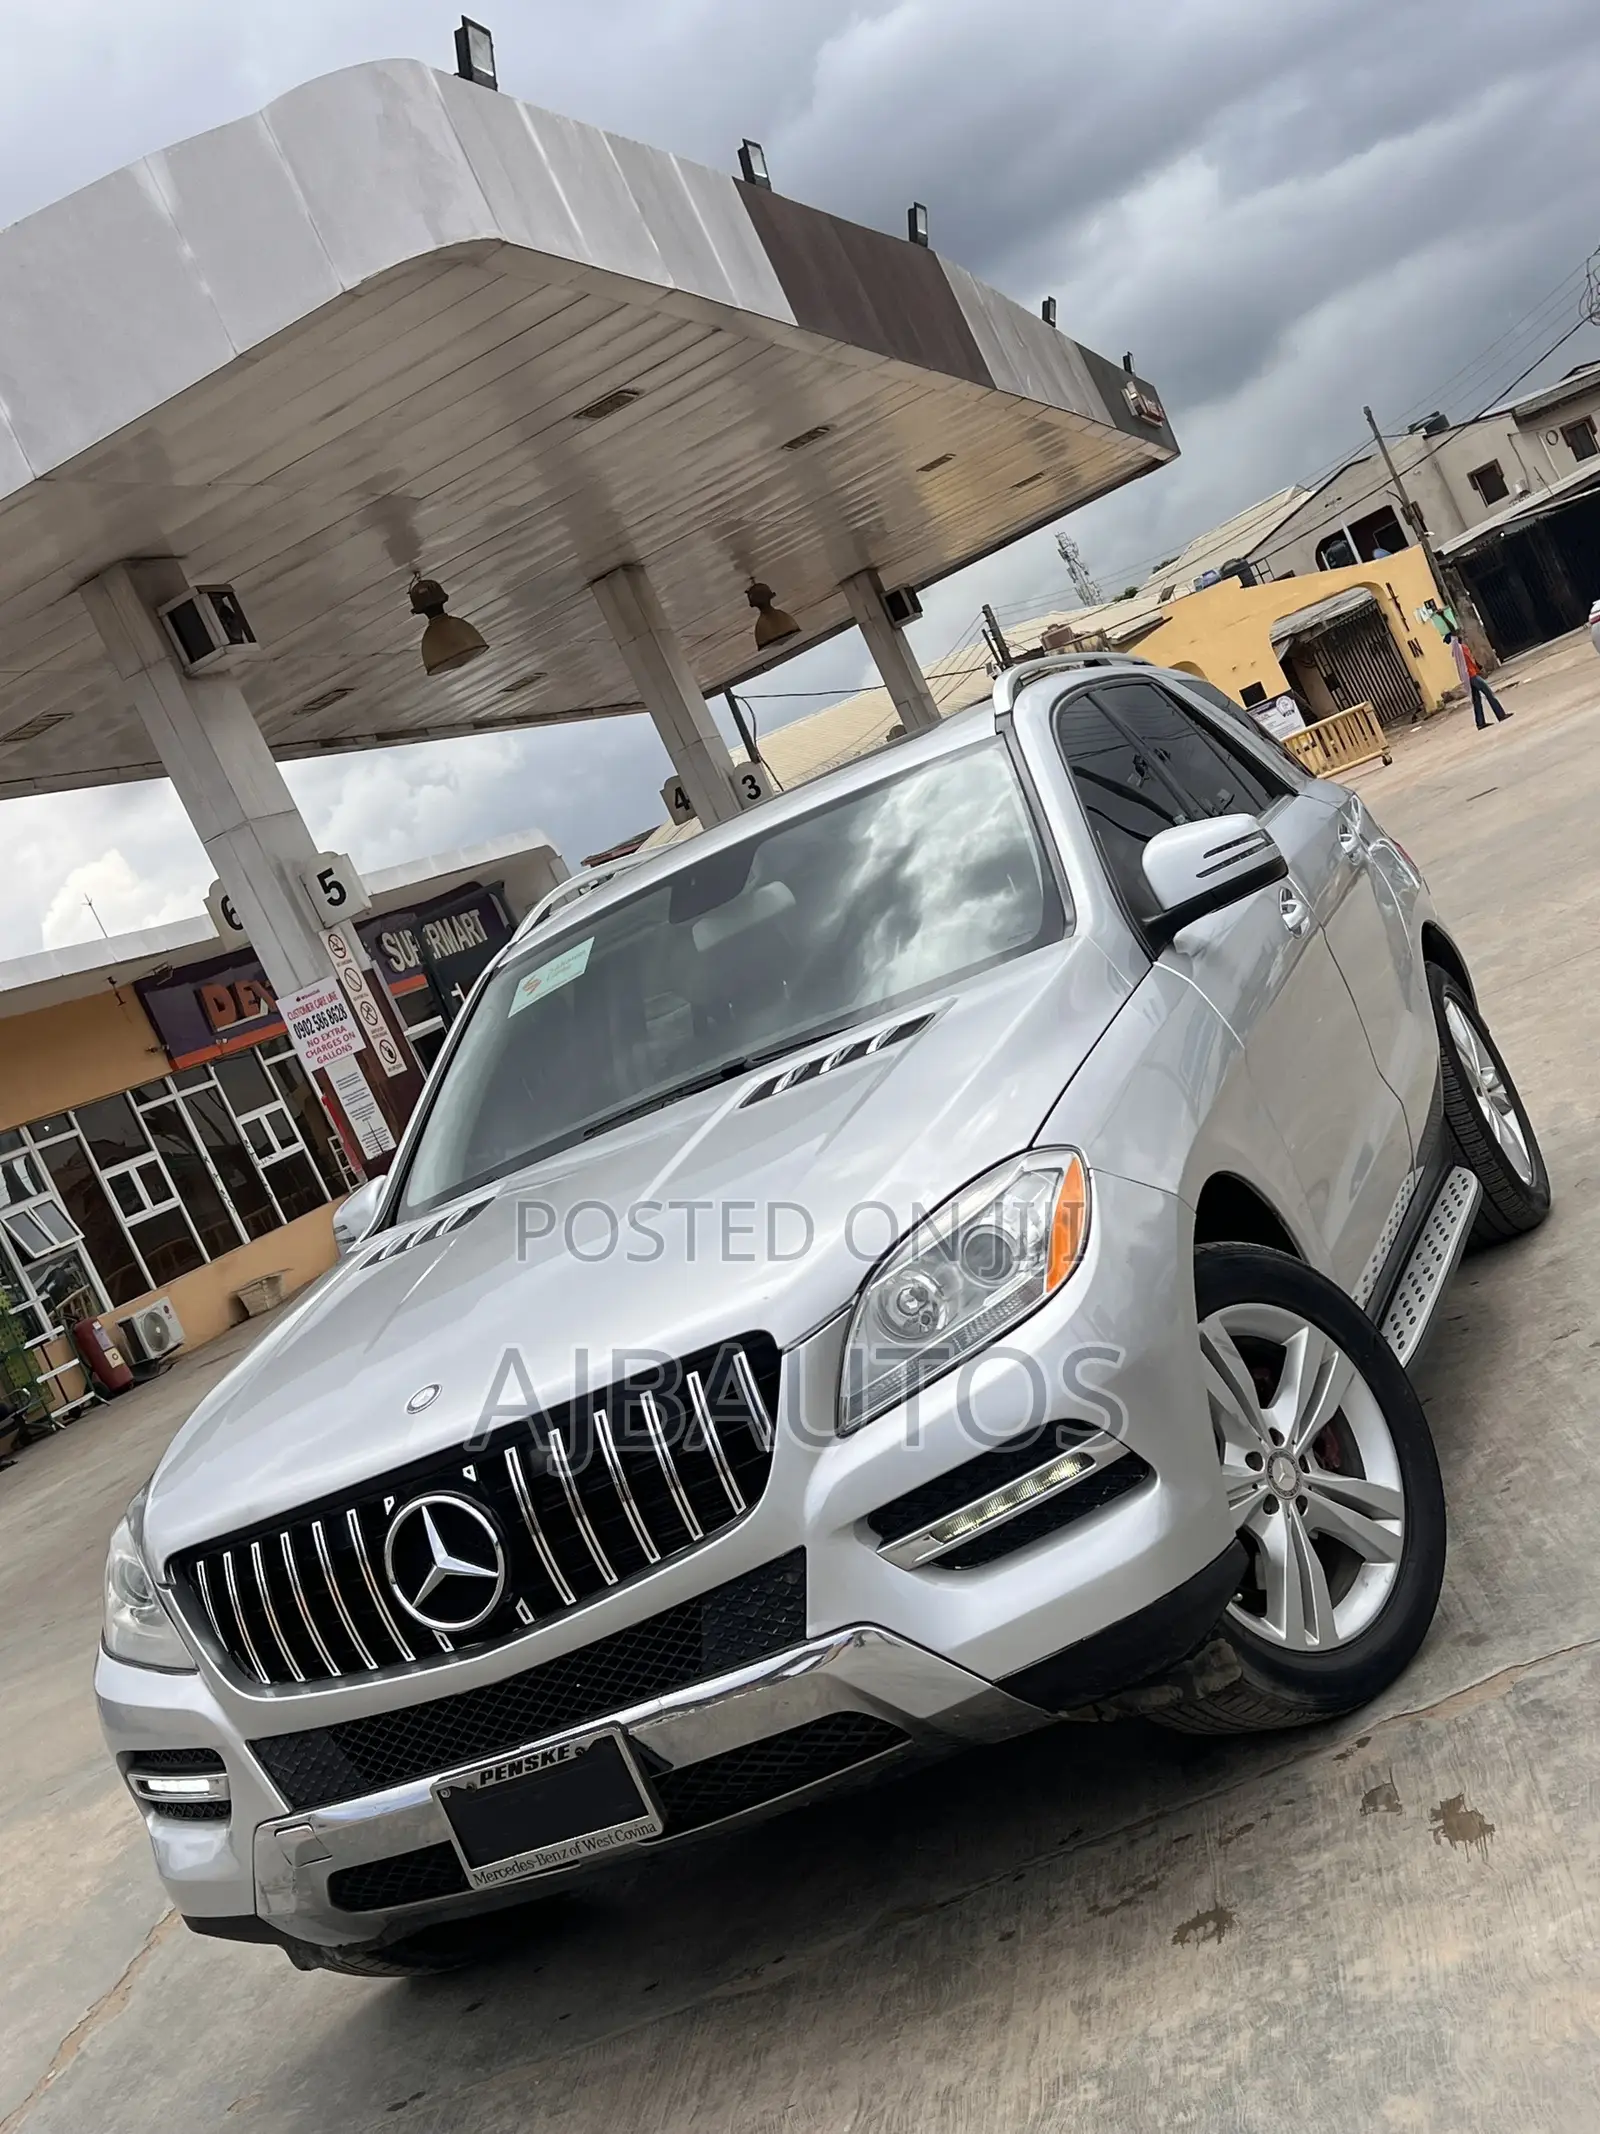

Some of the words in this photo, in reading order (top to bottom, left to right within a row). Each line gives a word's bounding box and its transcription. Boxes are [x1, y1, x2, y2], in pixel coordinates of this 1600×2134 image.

[674, 786, 691, 811] 4
[741, 774, 762, 800] 3
[316, 867, 347, 907] 5
[220, 894, 244, 931] 6
[287, 1002, 315, 1020] CUSTOMER
[313, 995, 328, 1009] CARE
[326, 991, 338, 1004] LINE
[293, 1018, 315, 1040] 0902
[311, 1011, 330, 1031] 586
[325, 1003, 348, 1025] 8628
[305, 1038, 341, 1059] CHARGES
[342, 1031, 356, 1041] ON
[306, 1036, 320, 1048] NO
[320, 1025, 347, 1041] EXTRA
[316, 1044, 353, 1064] GALLONS
[479, 1744, 570, 1786] PENSKE
[473, 1849, 569, 1886] Mercedes-Benz
[569, 1840, 582, 1857] of
[578, 1832, 616, 1852] West
[614, 1823, 658, 1844] Covina
